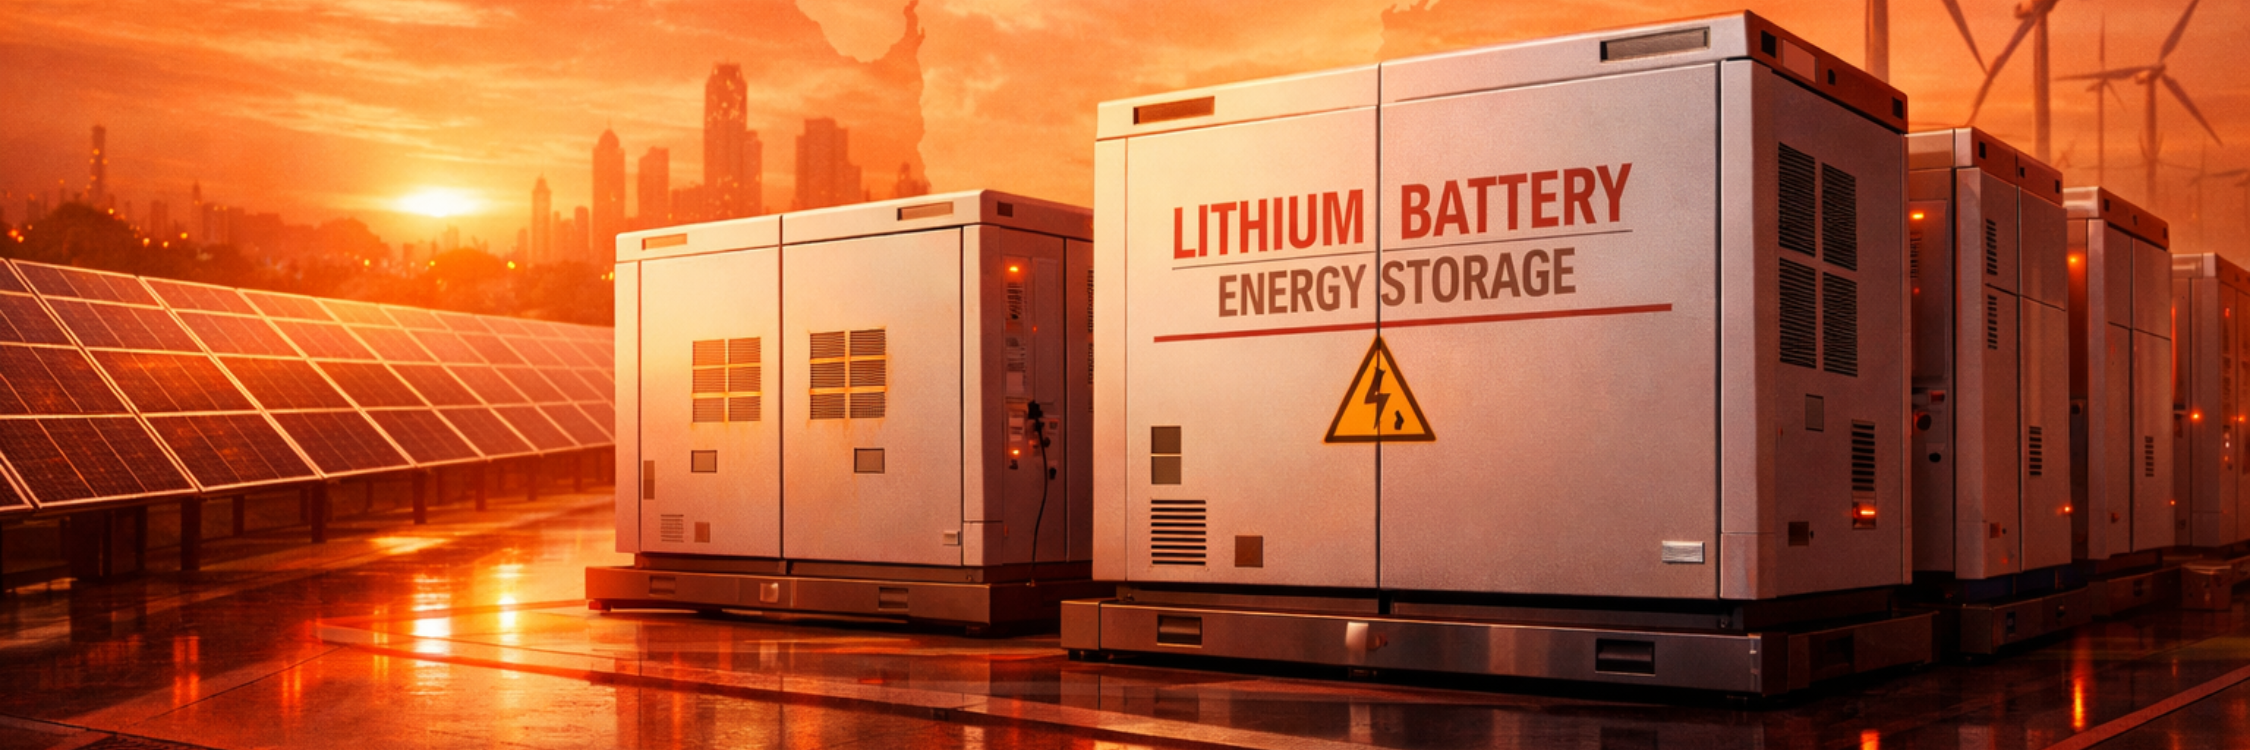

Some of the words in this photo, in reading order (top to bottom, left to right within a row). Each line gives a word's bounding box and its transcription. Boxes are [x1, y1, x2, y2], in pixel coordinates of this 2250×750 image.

[1173, 189, 1364, 260] LITHIUM
[1401, 162, 1633, 240] BATTERY
[1218, 264, 1367, 318] ENERGY
[1380, 247, 1577, 307] STORAGE
